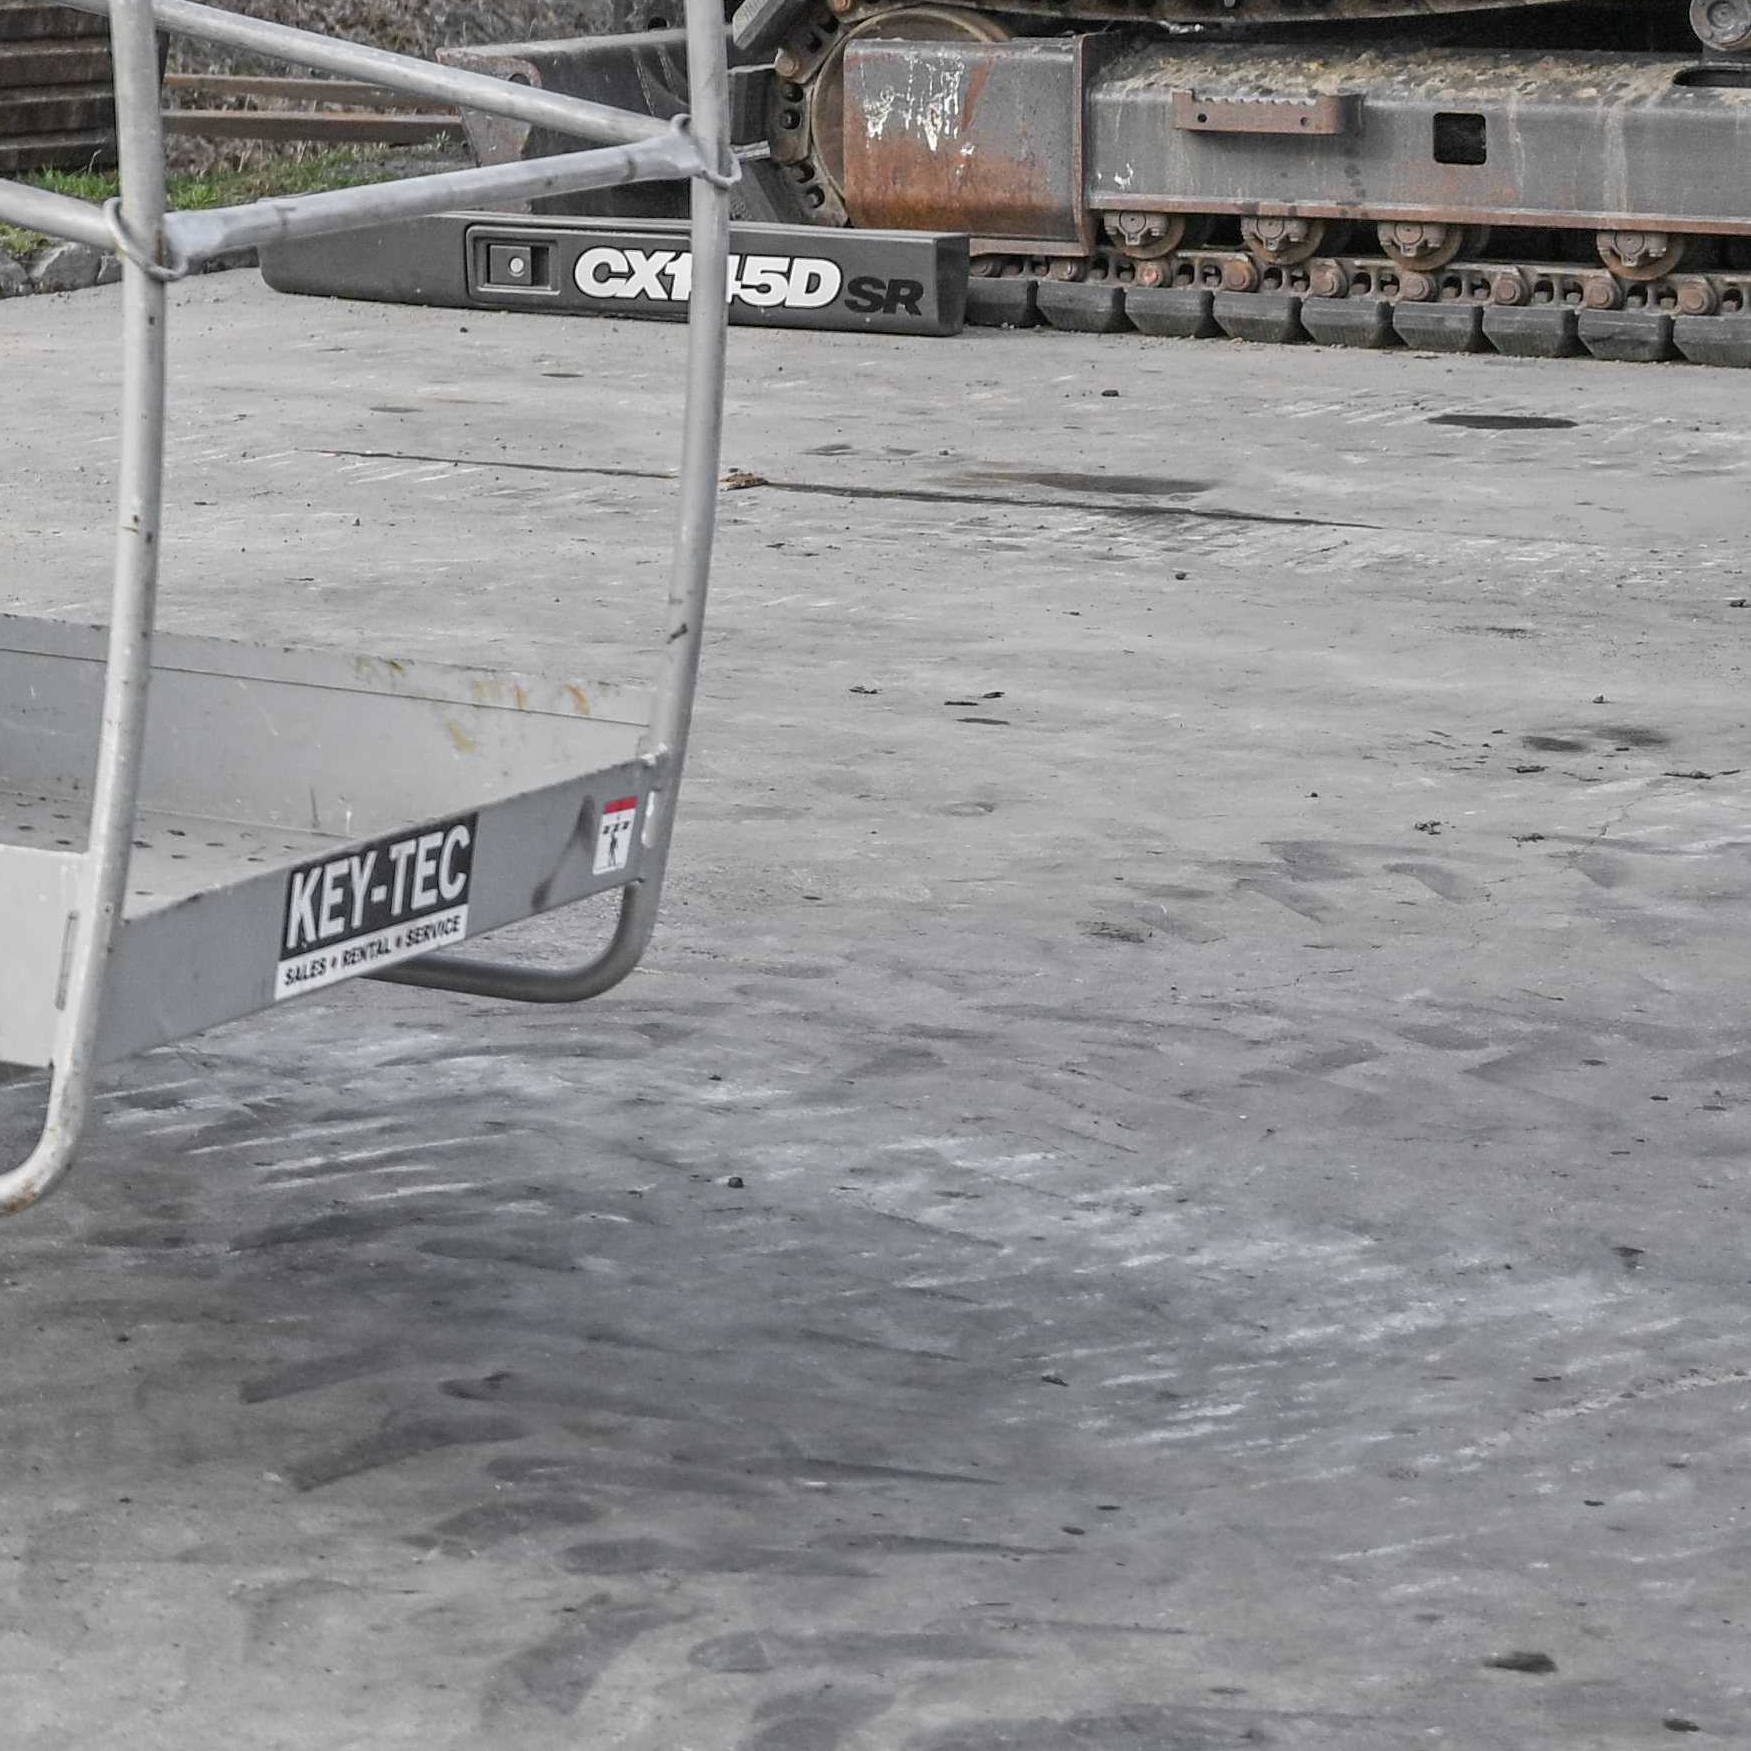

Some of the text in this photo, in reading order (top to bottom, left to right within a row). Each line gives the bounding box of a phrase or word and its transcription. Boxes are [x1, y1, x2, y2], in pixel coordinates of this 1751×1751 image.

[844, 276, 925, 316] SR
[286, 824, 470, 949] KEY-TEC
[285, 915, 461, 986] SALES RENTAL SERVICE
